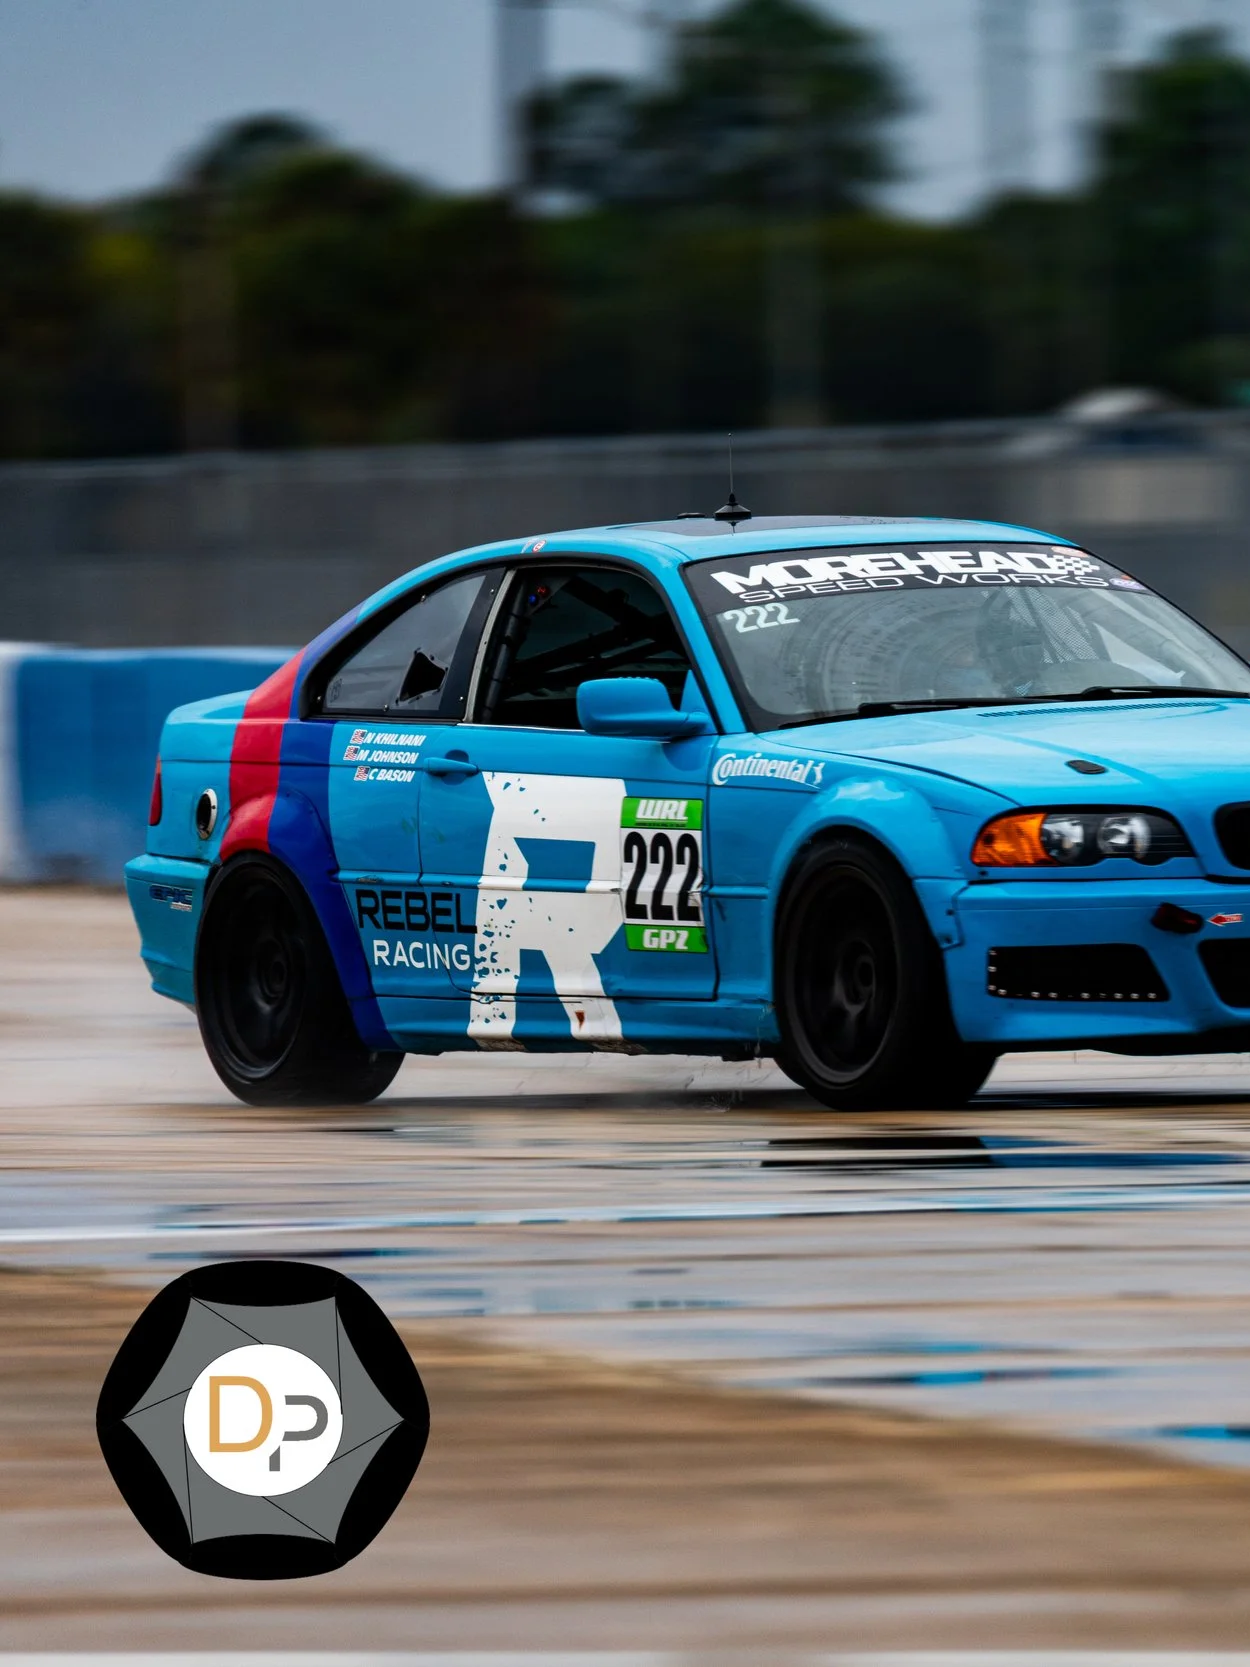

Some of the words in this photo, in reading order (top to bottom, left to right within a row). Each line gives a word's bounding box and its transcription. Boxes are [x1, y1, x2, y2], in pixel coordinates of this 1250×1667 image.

[710, 551, 1069, 594] MOREHEAD
[739, 577, 905, 603] SPEED
[914, 573, 1110, 587] WORKS
[723, 602, 800, 634] 222
[363, 732, 376, 744] N
[373, 733, 427, 746] KHILNANI
[356, 750, 370, 761] M
[368, 750, 419, 764] JOHNSON
[711, 753, 814, 785] Continental
[368, 768, 378, 780] C
[376, 769, 416, 782] BASON
[635, 799, 689, 820] WRL
[623, 831, 702, 922] 222
[355, 889, 478, 934] REBEL
[373, 939, 471, 971] RACING
